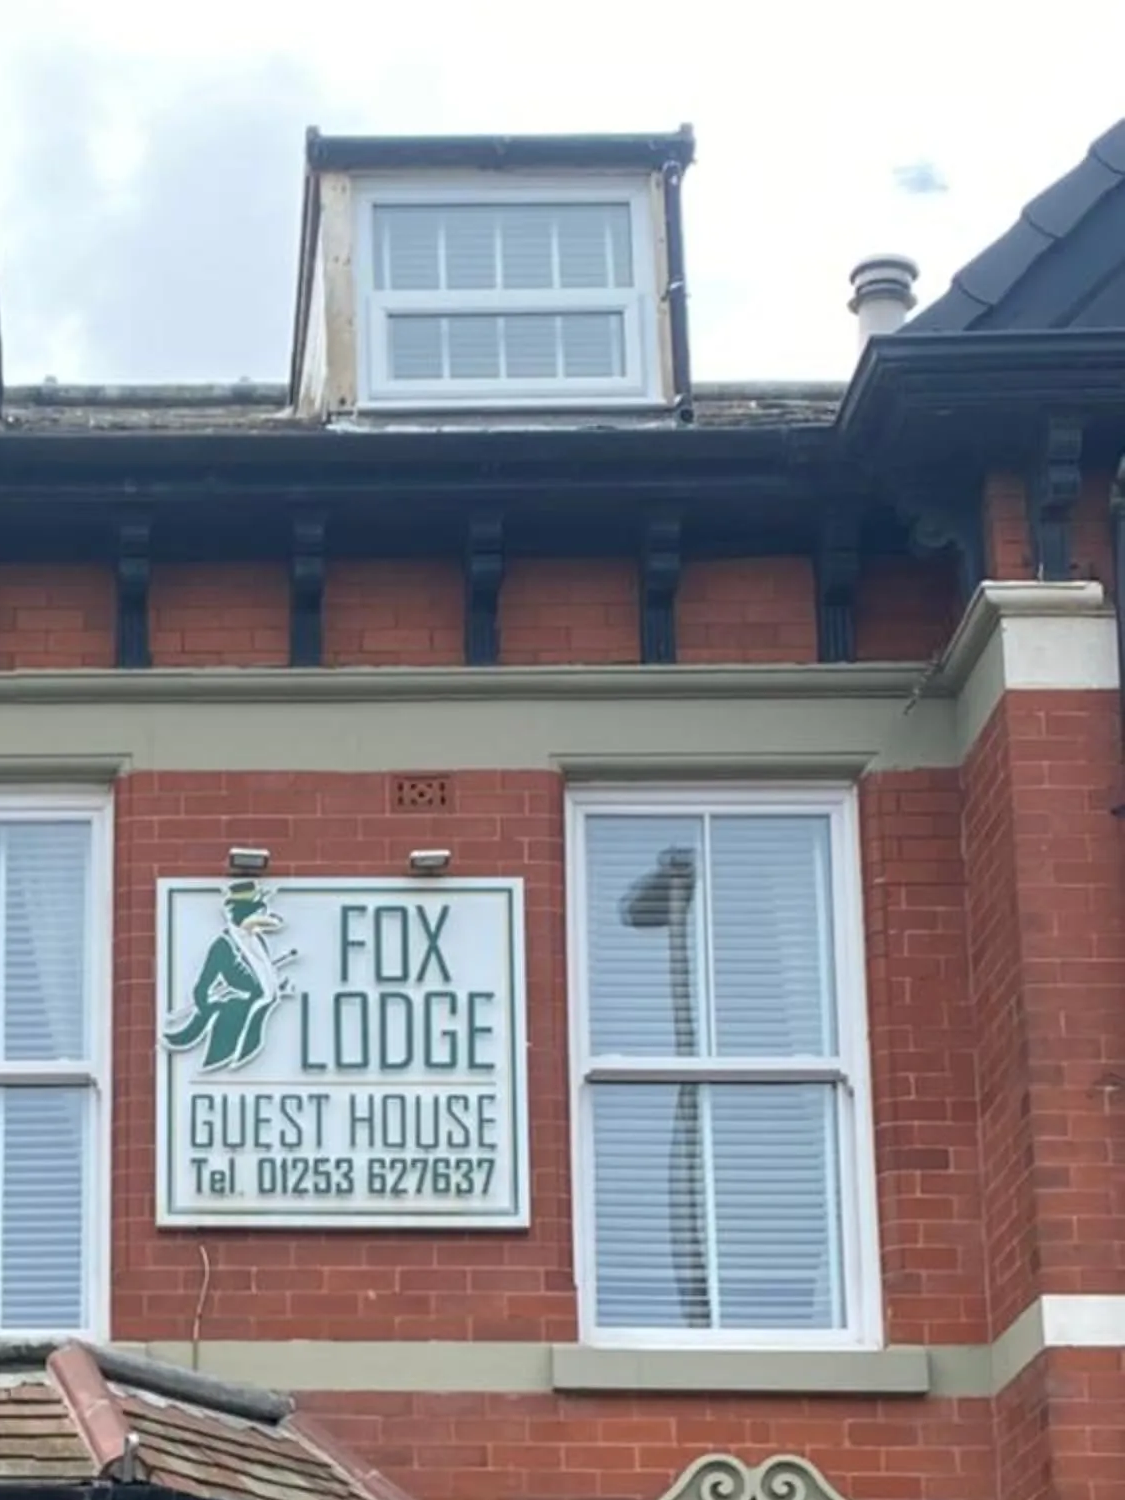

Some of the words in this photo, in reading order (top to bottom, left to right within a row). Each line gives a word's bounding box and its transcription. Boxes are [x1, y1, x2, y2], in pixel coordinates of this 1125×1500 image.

[340, 905, 452, 983] FOX
[301, 991, 496, 1072] LODGE
[190, 1093, 331, 1150] GUEST
[350, 1093, 497, 1151] HOUSE
[257, 1157, 355, 1196] 01253
[367, 1157, 496, 1196] 627637
